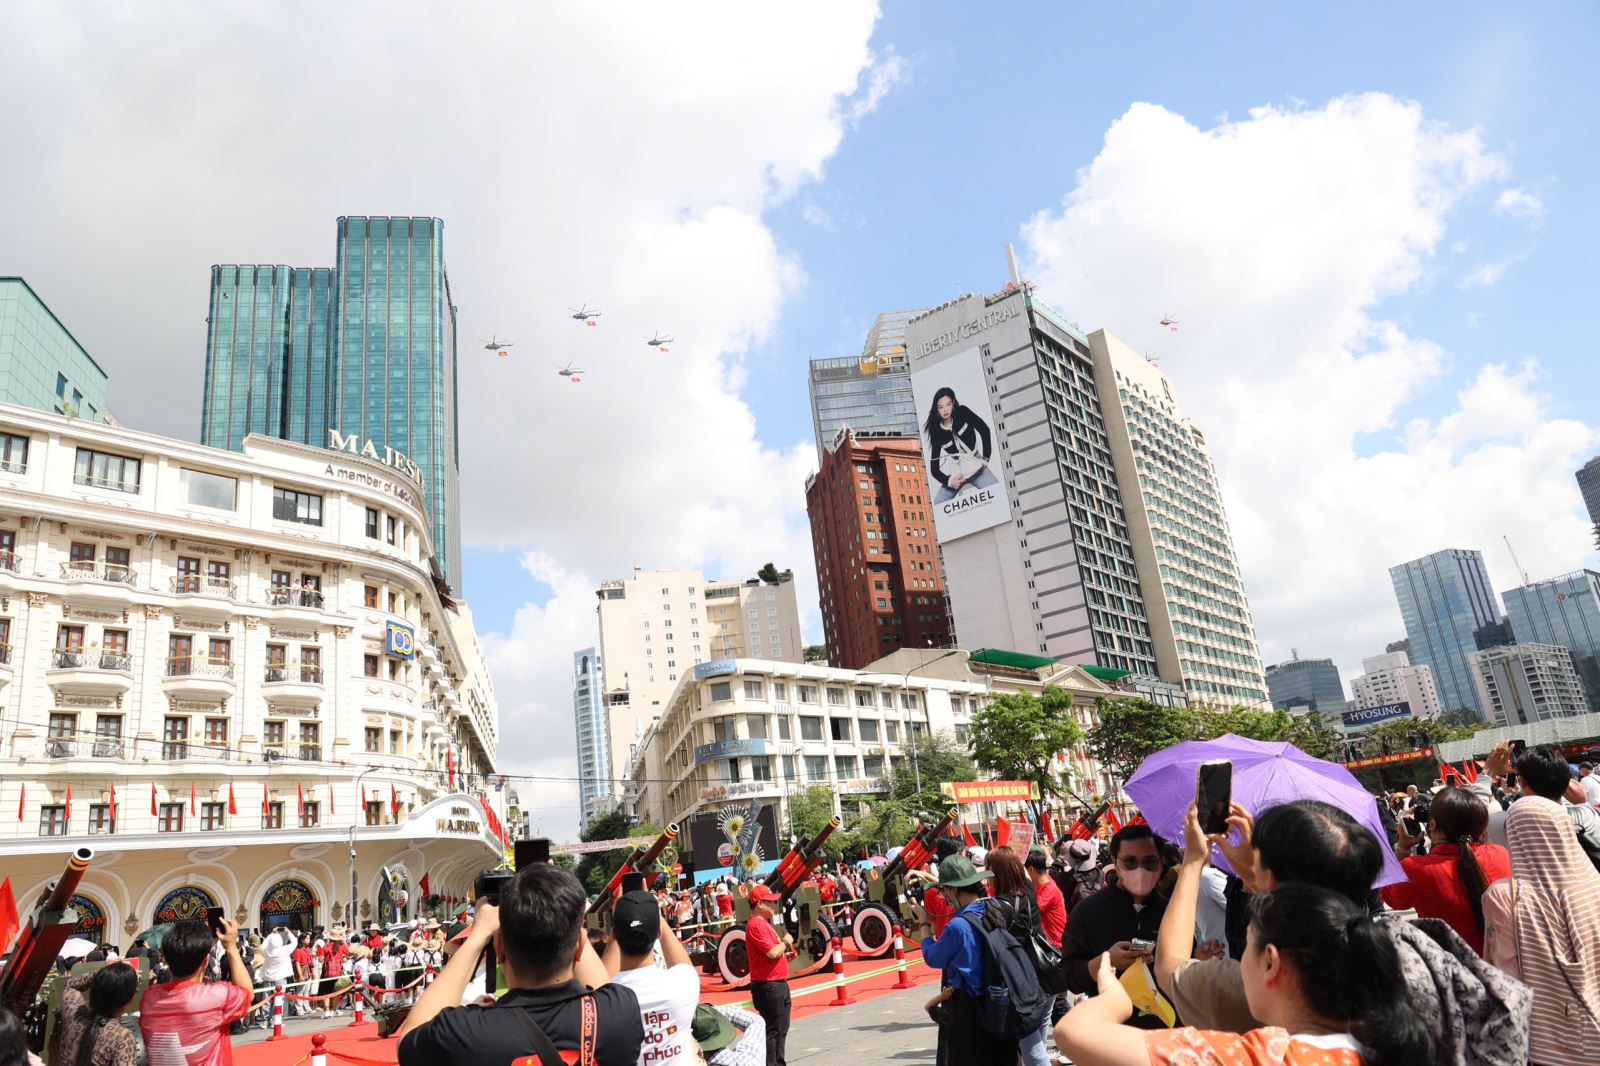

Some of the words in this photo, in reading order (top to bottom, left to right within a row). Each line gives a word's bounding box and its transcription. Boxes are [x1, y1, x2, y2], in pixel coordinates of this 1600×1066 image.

[914, 325, 961, 360] LIBERTY
[961, 303, 1020, 338] CENTRAL
[328, 429, 424, 488] MAJEST
[325, 464, 334, 476] A
[337, 468, 382, 487] member
[943, 490, 995, 514] CHANEL
[1350, 705, 1401, 721] HYOSUNG
[436, 819, 480, 834] MAJESTIC
[584, 1002, 594, 1037] adidas
[644, 1011, 669, 1028] lập
[644, 1031, 663, 1044] do
[643, 1045, 681, 1066] phúc
